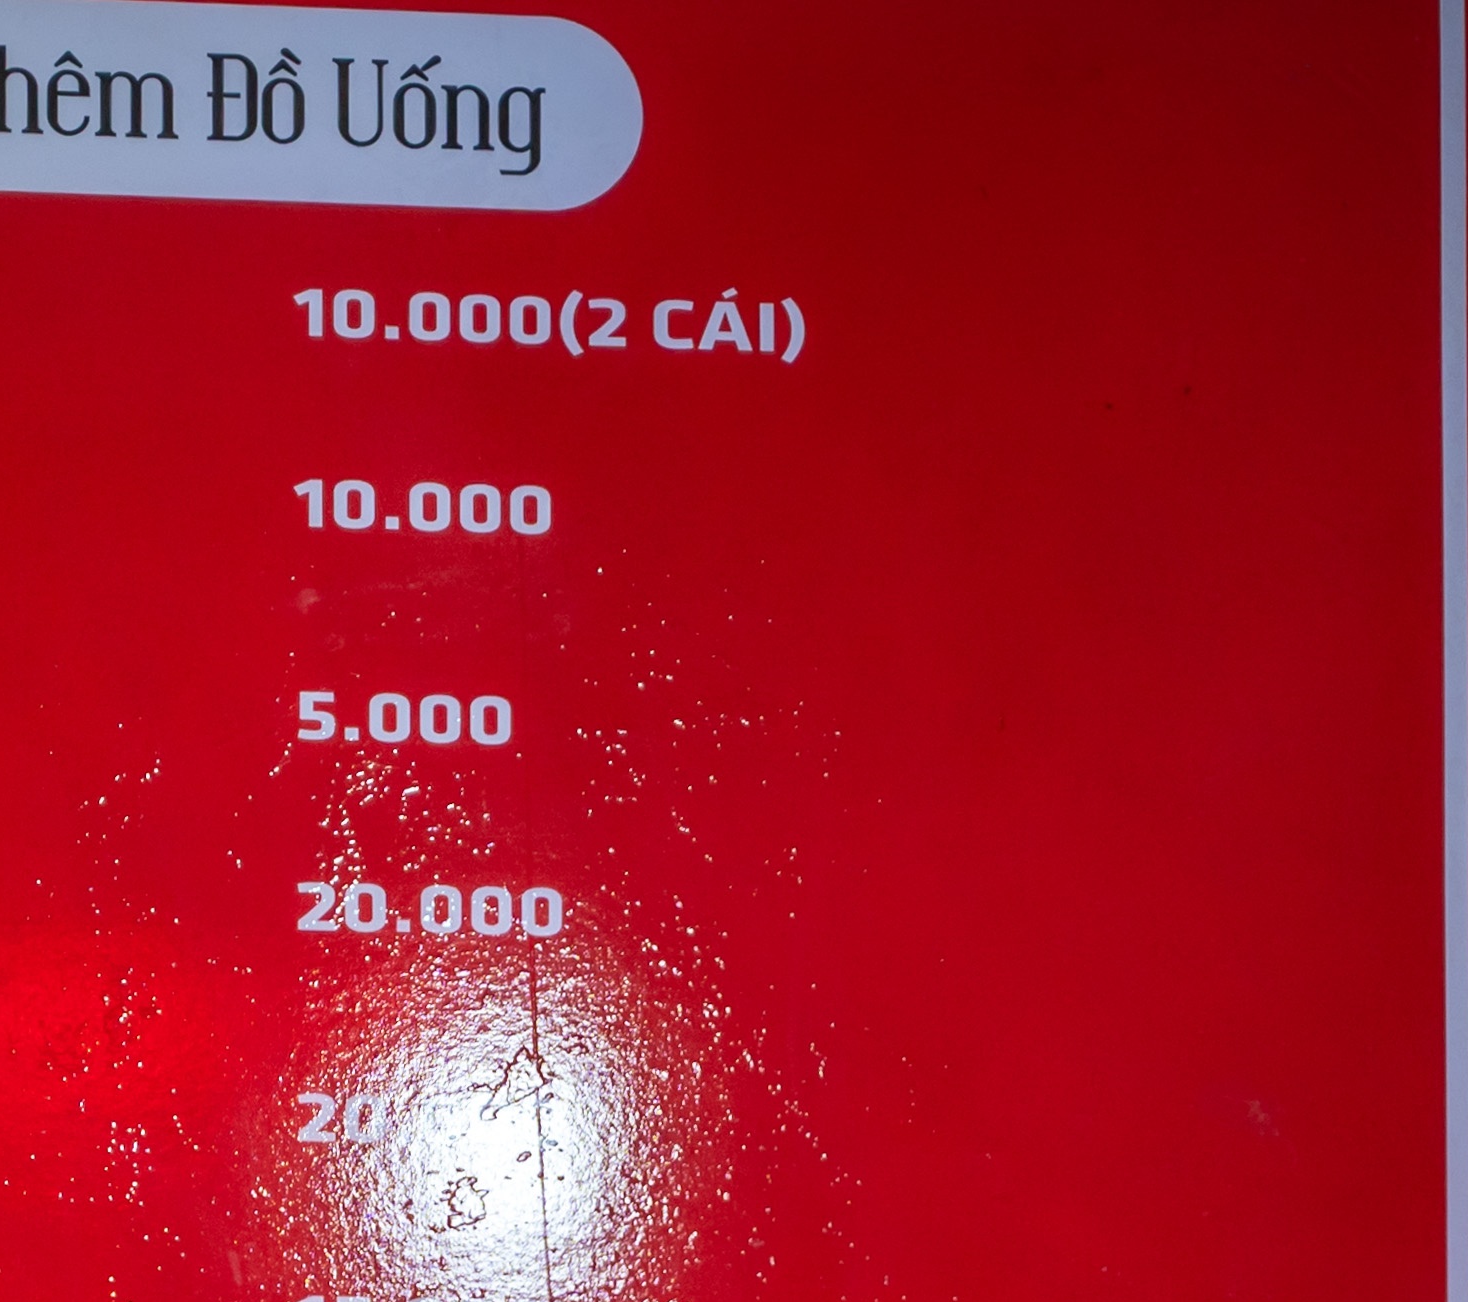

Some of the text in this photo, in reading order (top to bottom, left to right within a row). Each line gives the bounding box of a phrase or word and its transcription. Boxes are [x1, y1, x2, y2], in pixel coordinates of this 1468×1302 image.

[207, 48, 305, 144] Đồ
[332, 55, 546, 176] Uống
[294, 288, 804, 363] 10.000(2 CÁI)
[294, 480, 551, 534] 10.000
[298, 691, 511, 745] 5.000
[297, 882, 563, 936] 20.000
